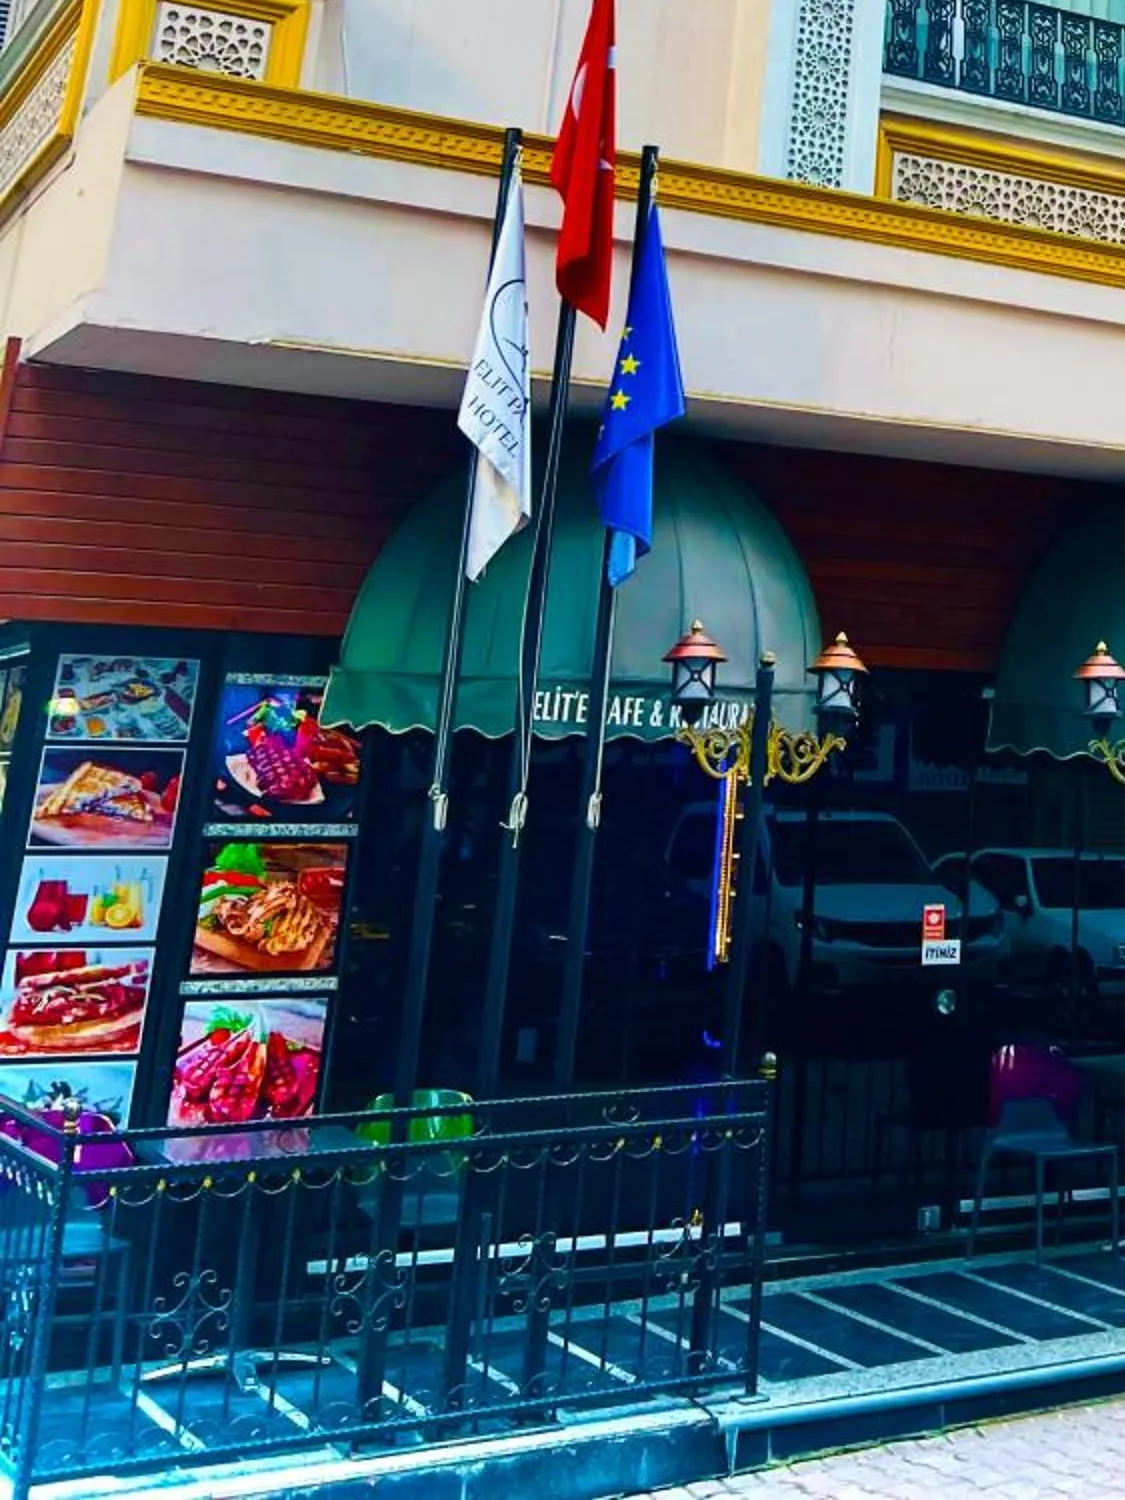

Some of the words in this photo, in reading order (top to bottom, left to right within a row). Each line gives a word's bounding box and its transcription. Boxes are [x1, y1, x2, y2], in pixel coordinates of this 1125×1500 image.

[467, 395, 520, 458] HOTEL
[606, 695, 645, 727] AFE
[649, 699, 663, 727] &
